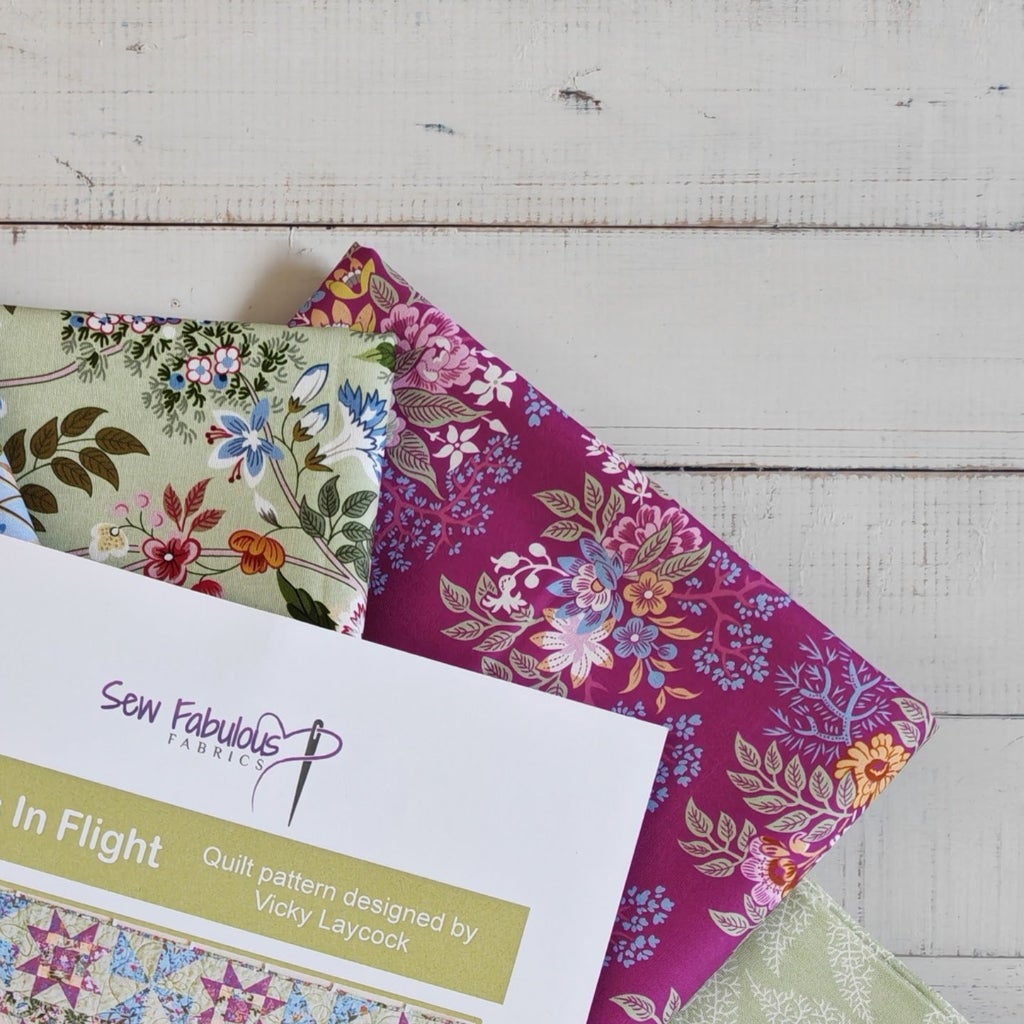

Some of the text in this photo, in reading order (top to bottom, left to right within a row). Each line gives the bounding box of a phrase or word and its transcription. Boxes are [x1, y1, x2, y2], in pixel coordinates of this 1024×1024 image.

[100, 680, 282, 757] Sew Fabulous
[167, 732, 265, 771] FABRICS
[12, 795, 47, 835] In
[56, 808, 163, 868] Flight
[202, 846, 479, 945] Quilt pattern designed by
[255, 890, 410, 953] Vicky Laycock
